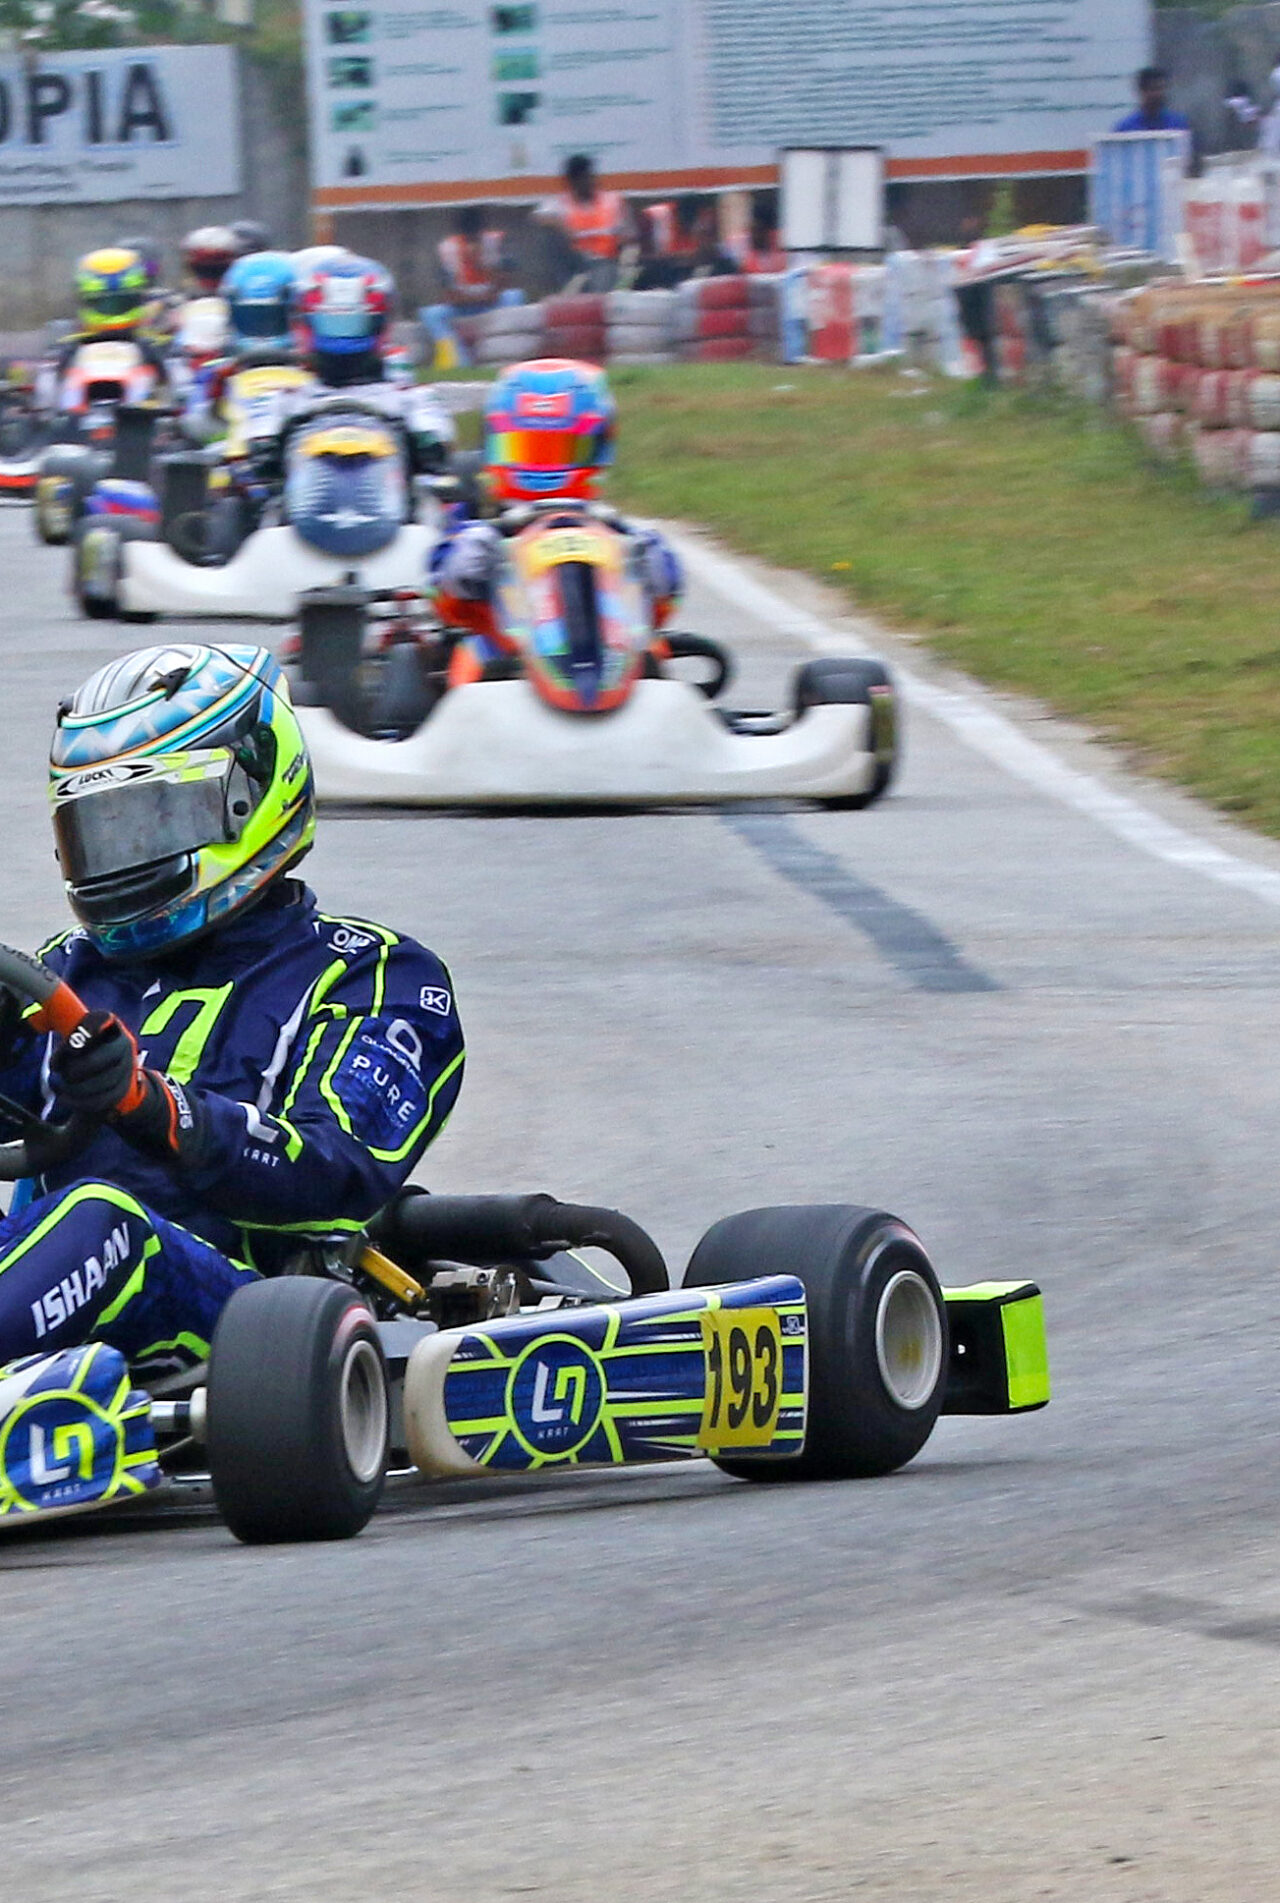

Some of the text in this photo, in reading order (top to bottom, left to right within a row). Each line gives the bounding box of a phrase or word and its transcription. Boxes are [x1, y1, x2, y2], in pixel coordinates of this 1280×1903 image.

[78, 768, 115, 785] LUCKY
[351, 1054, 417, 1122] PURE
[30, 1221, 131, 1339] ISHAAN
[707, 1325, 777, 1430] 193
